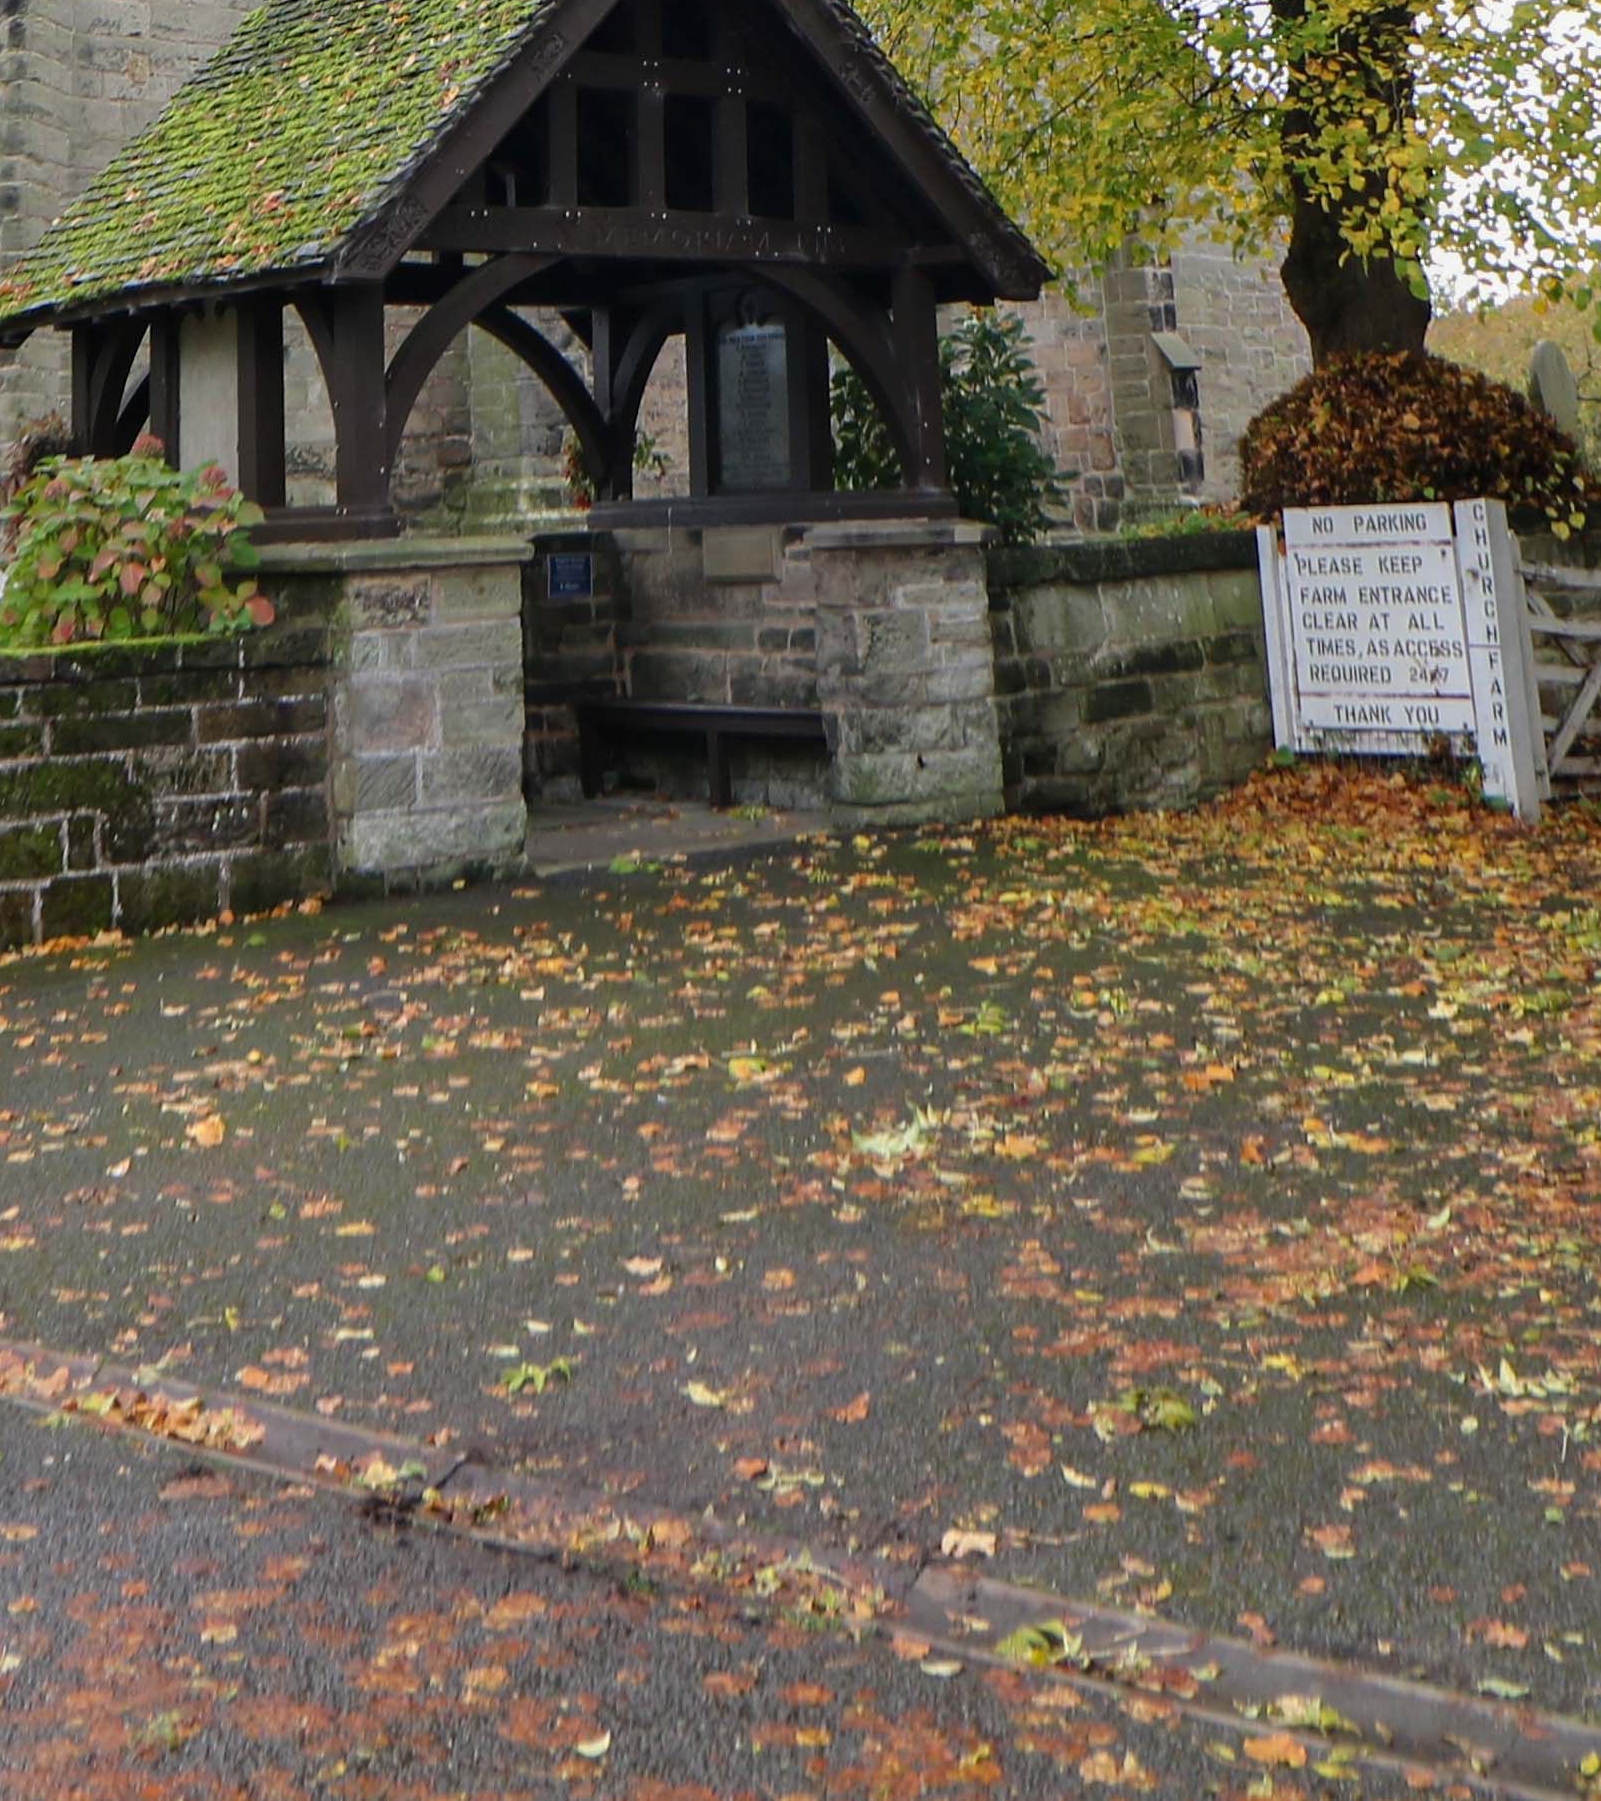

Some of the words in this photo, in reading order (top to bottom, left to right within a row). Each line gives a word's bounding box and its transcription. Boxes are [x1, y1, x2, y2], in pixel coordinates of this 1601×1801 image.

[1311, 516, 1335, 534] NO
[1353, 513, 1428, 533] PARKING
[1297, 556, 1364, 576] PLEASE
[1378, 554, 1422, 574] KEEP
[1472, 502, 1499, 644] CHURCH
[1300, 585, 1348, 605] FARM
[1358, 584, 1453, 605] ENTRANCE
[1302, 611, 1359, 631] CLEAR
[1369, 611, 1391, 630] AT
[1408, 610, 1445, 630] ALL
[1306, 637, 1363, 660] TIMES,
[1366, 637, 1390, 657] AS
[1393, 637, 1463, 659] ACCESS
[1309, 662, 1392, 684] REQUIRED
[1488, 650, 1508, 746] FARM
[1334, 704, 1392, 725] THANK
[1403, 704, 1440, 725] YOU
